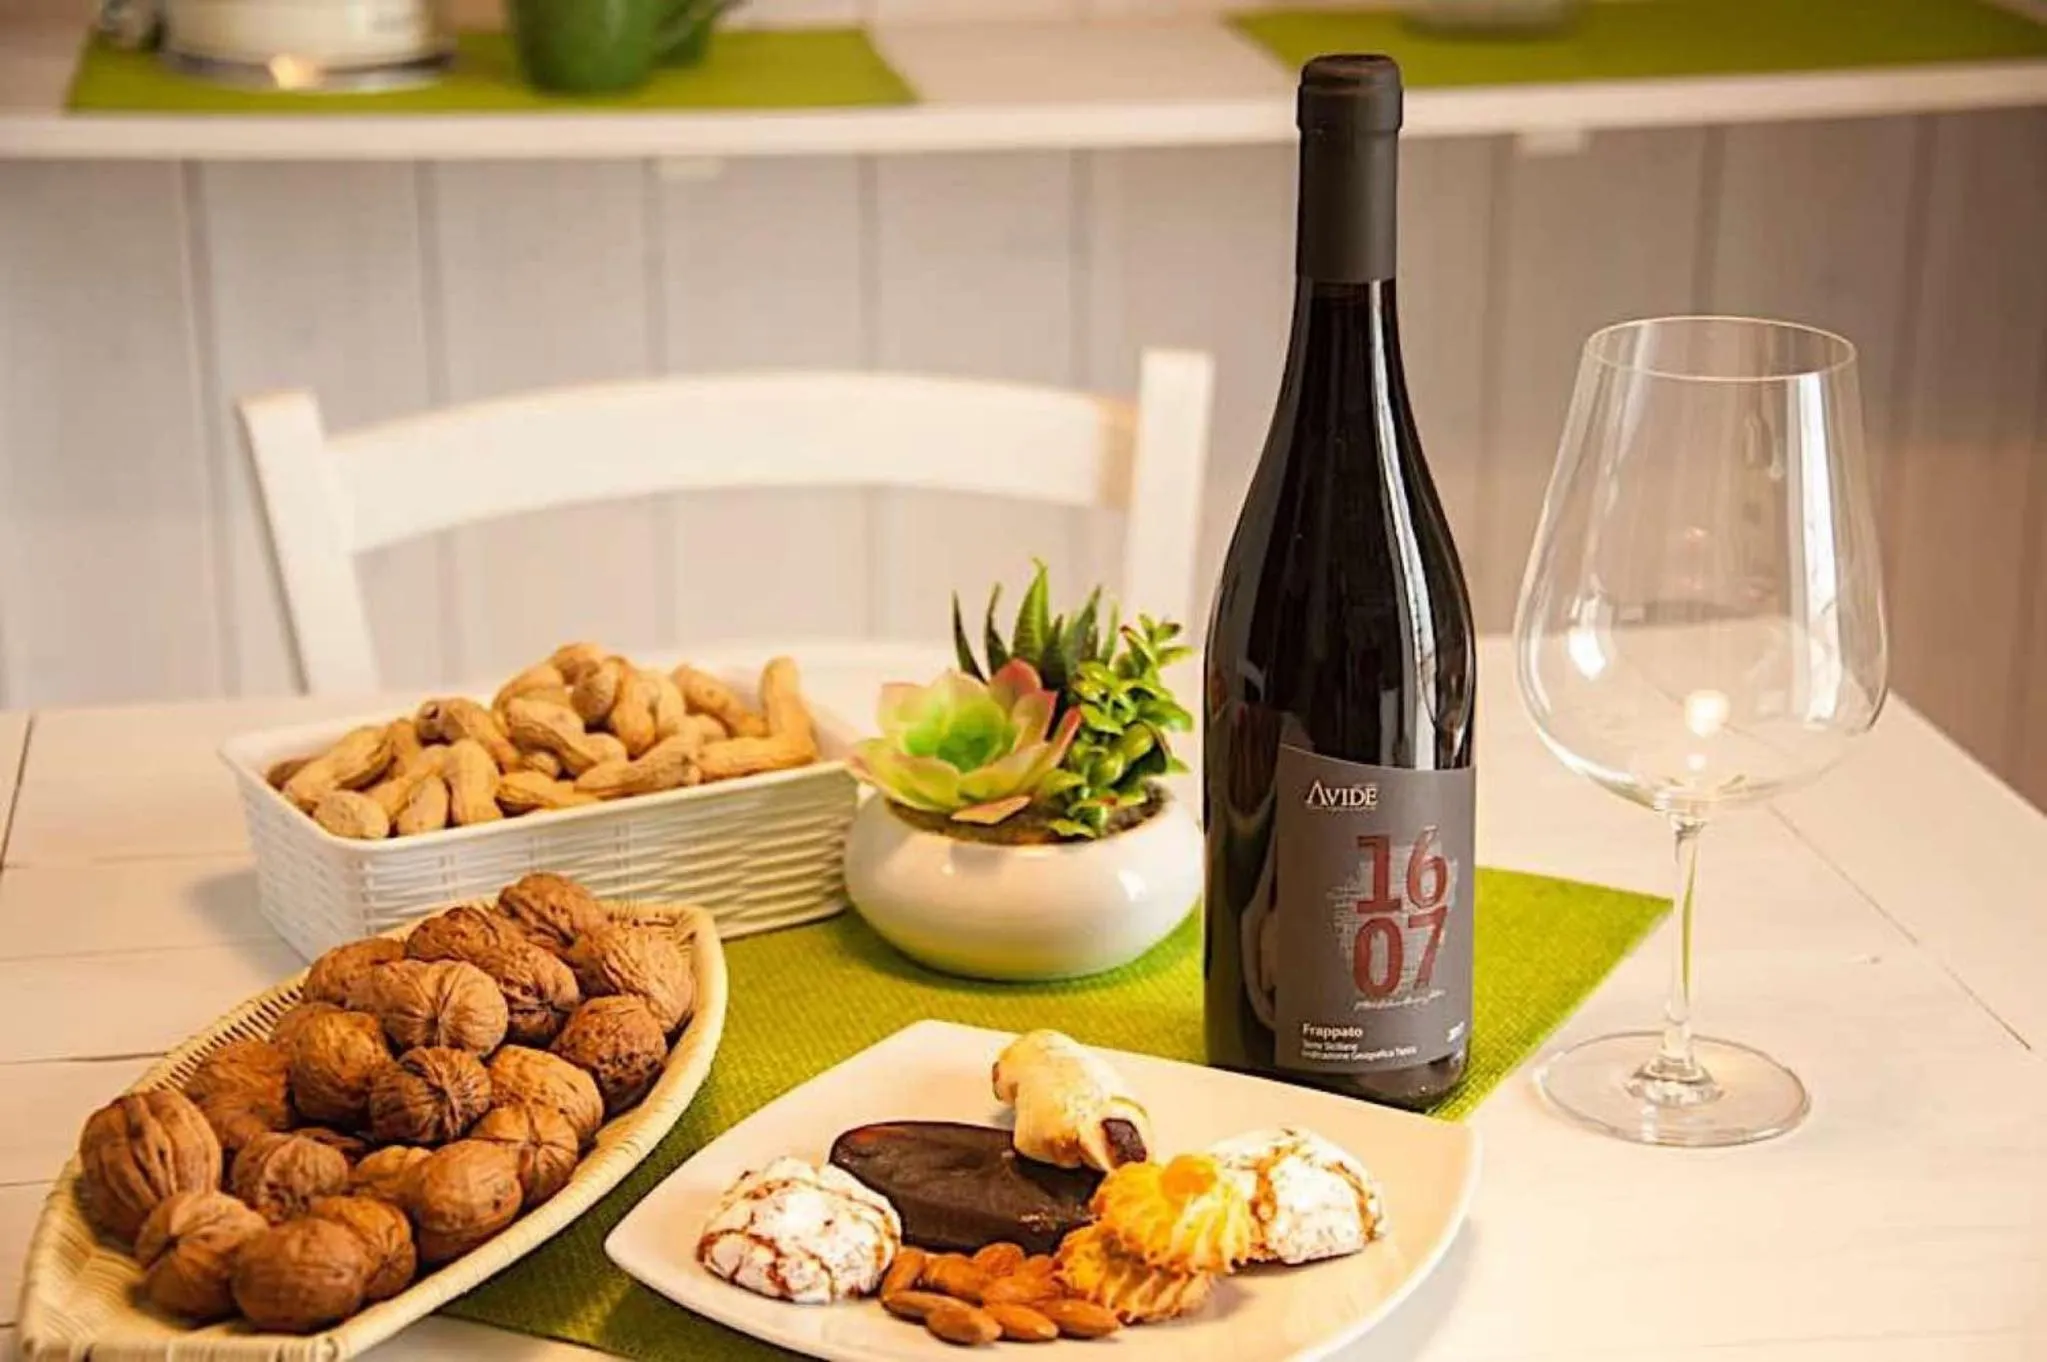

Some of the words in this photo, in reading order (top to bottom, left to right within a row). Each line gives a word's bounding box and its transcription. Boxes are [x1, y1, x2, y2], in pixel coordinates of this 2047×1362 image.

[1356, 826, 1448, 914] 16
[1353, 905, 1448, 999] 07
[1302, 1023, 1363, 1040] Frappato
